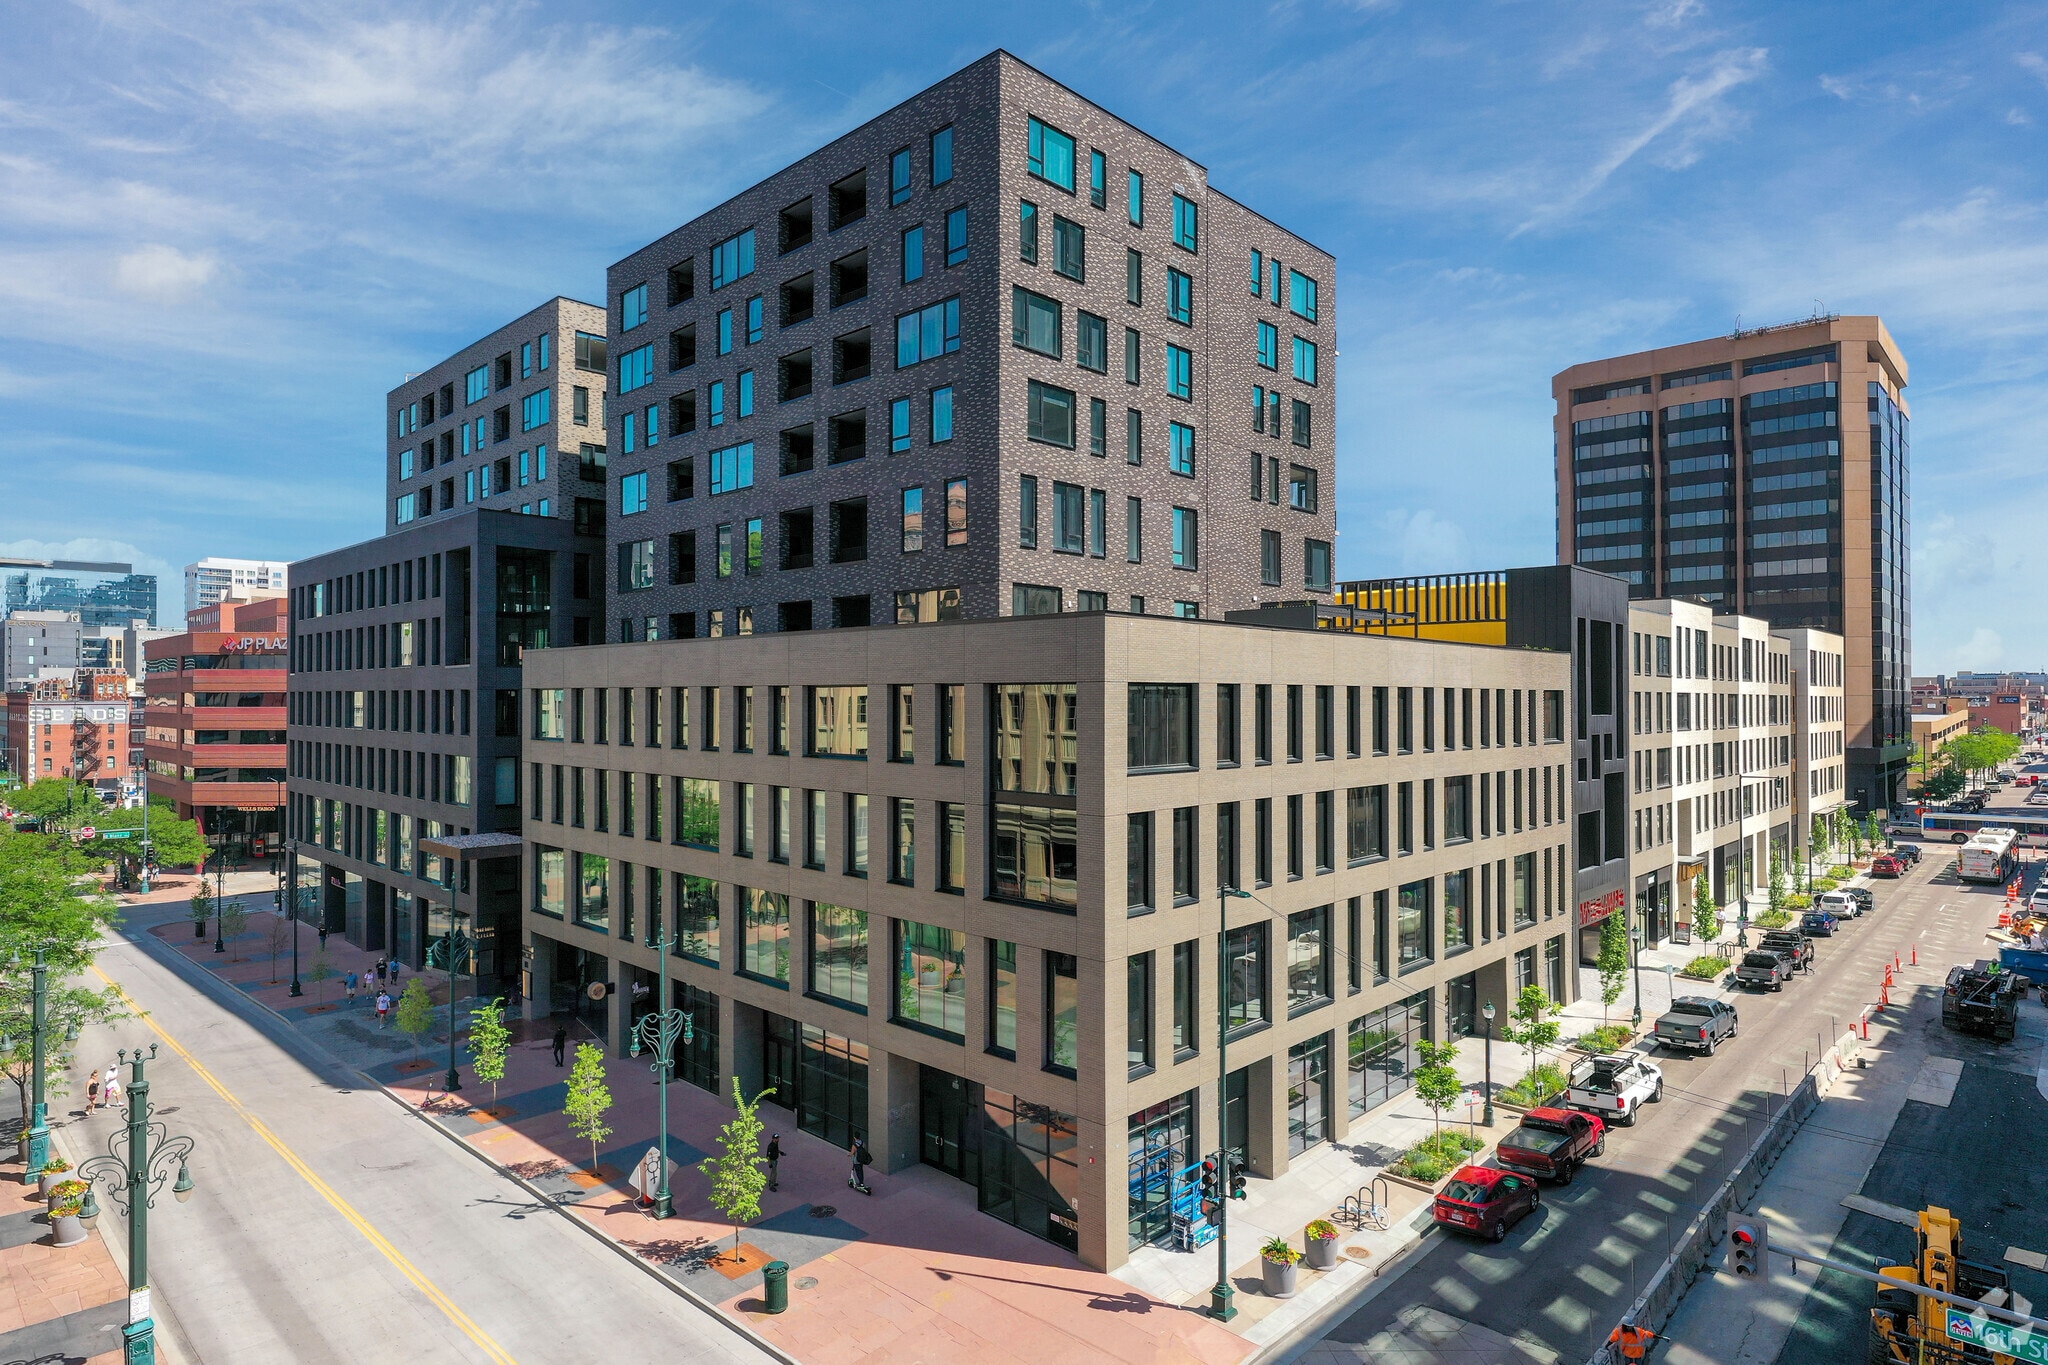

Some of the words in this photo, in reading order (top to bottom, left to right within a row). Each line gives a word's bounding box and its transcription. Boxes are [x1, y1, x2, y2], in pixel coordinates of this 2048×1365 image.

[237, 637, 253, 650] JP
[1975, 1323, 2021, 1353] 16th
[2028, 1339, 2048, 1362] St
